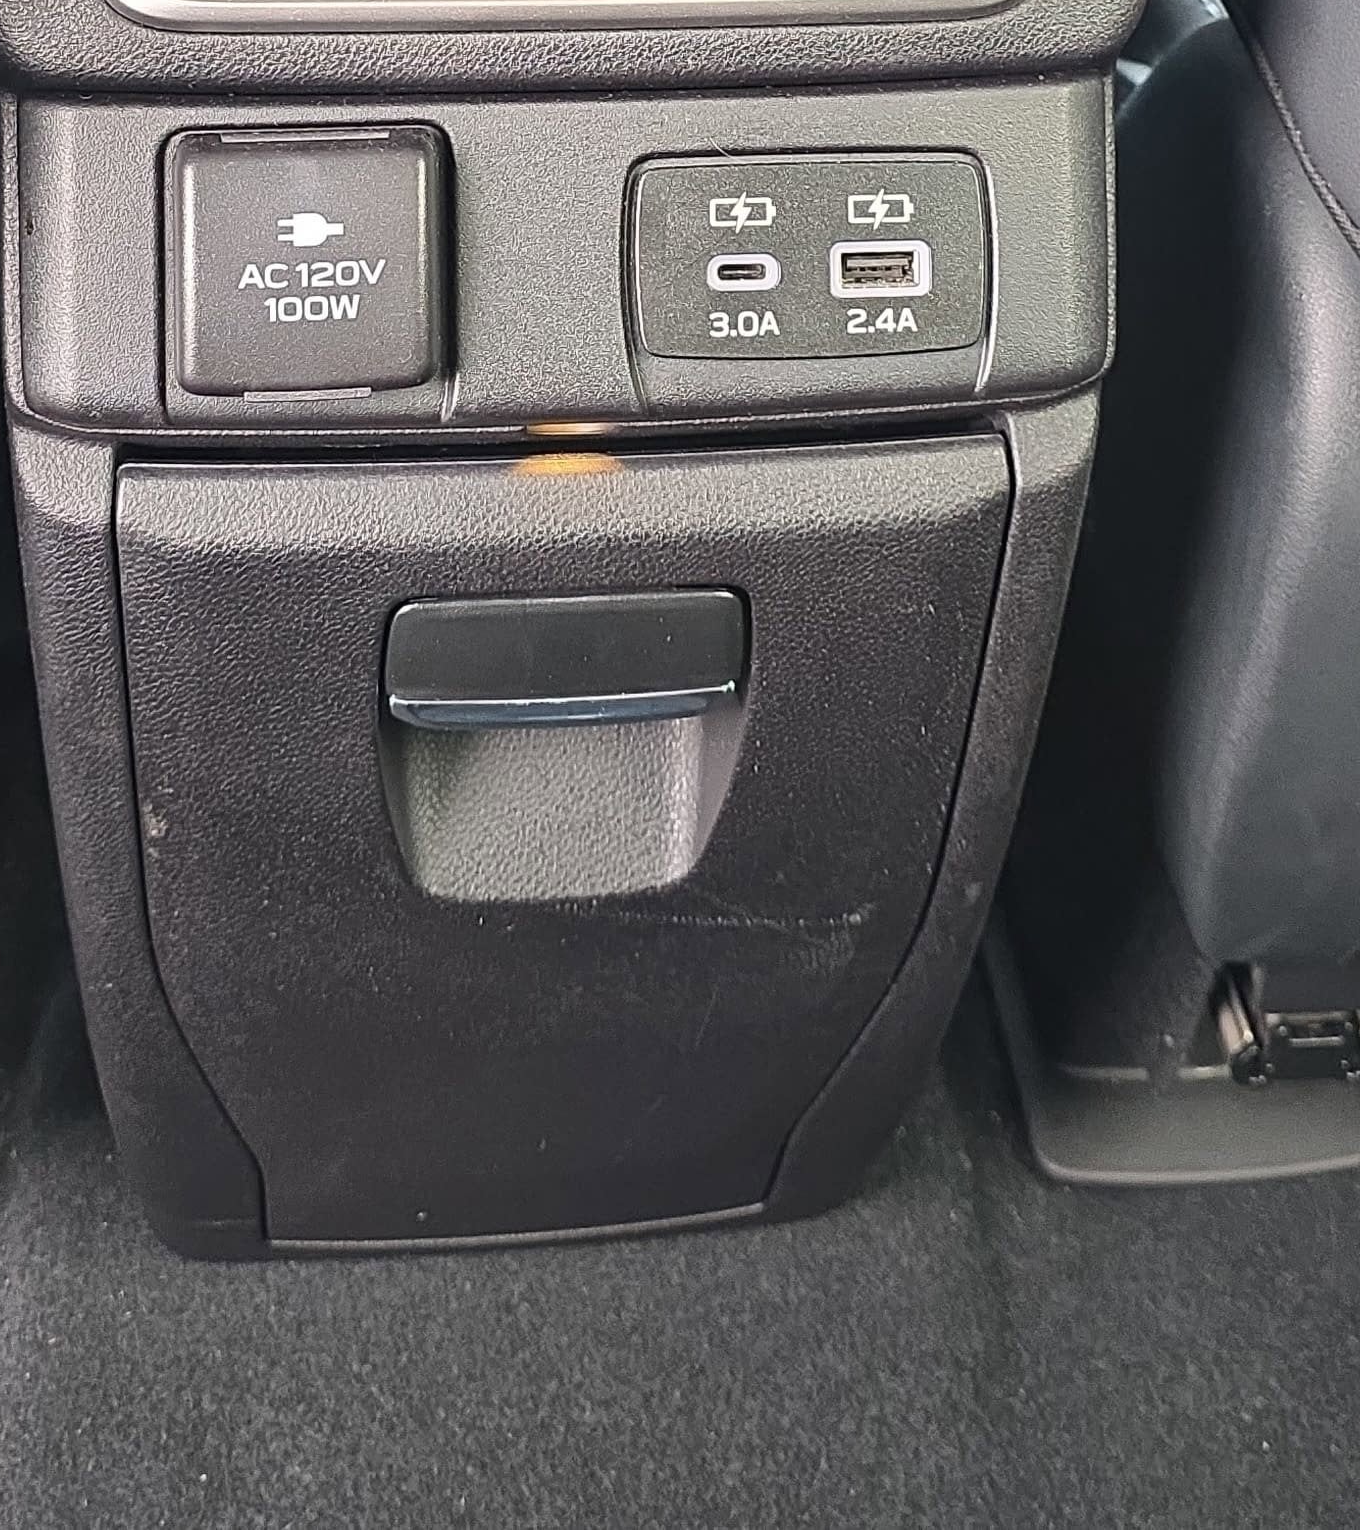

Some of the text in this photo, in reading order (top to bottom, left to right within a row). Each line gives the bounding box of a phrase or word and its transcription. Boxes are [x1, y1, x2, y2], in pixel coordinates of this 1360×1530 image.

[237, 258, 386, 289] AC 120V
[263, 294, 361, 323] 100W
[846, 307, 919, 334] 2.4A
[709, 310, 781, 338] 3.0A
